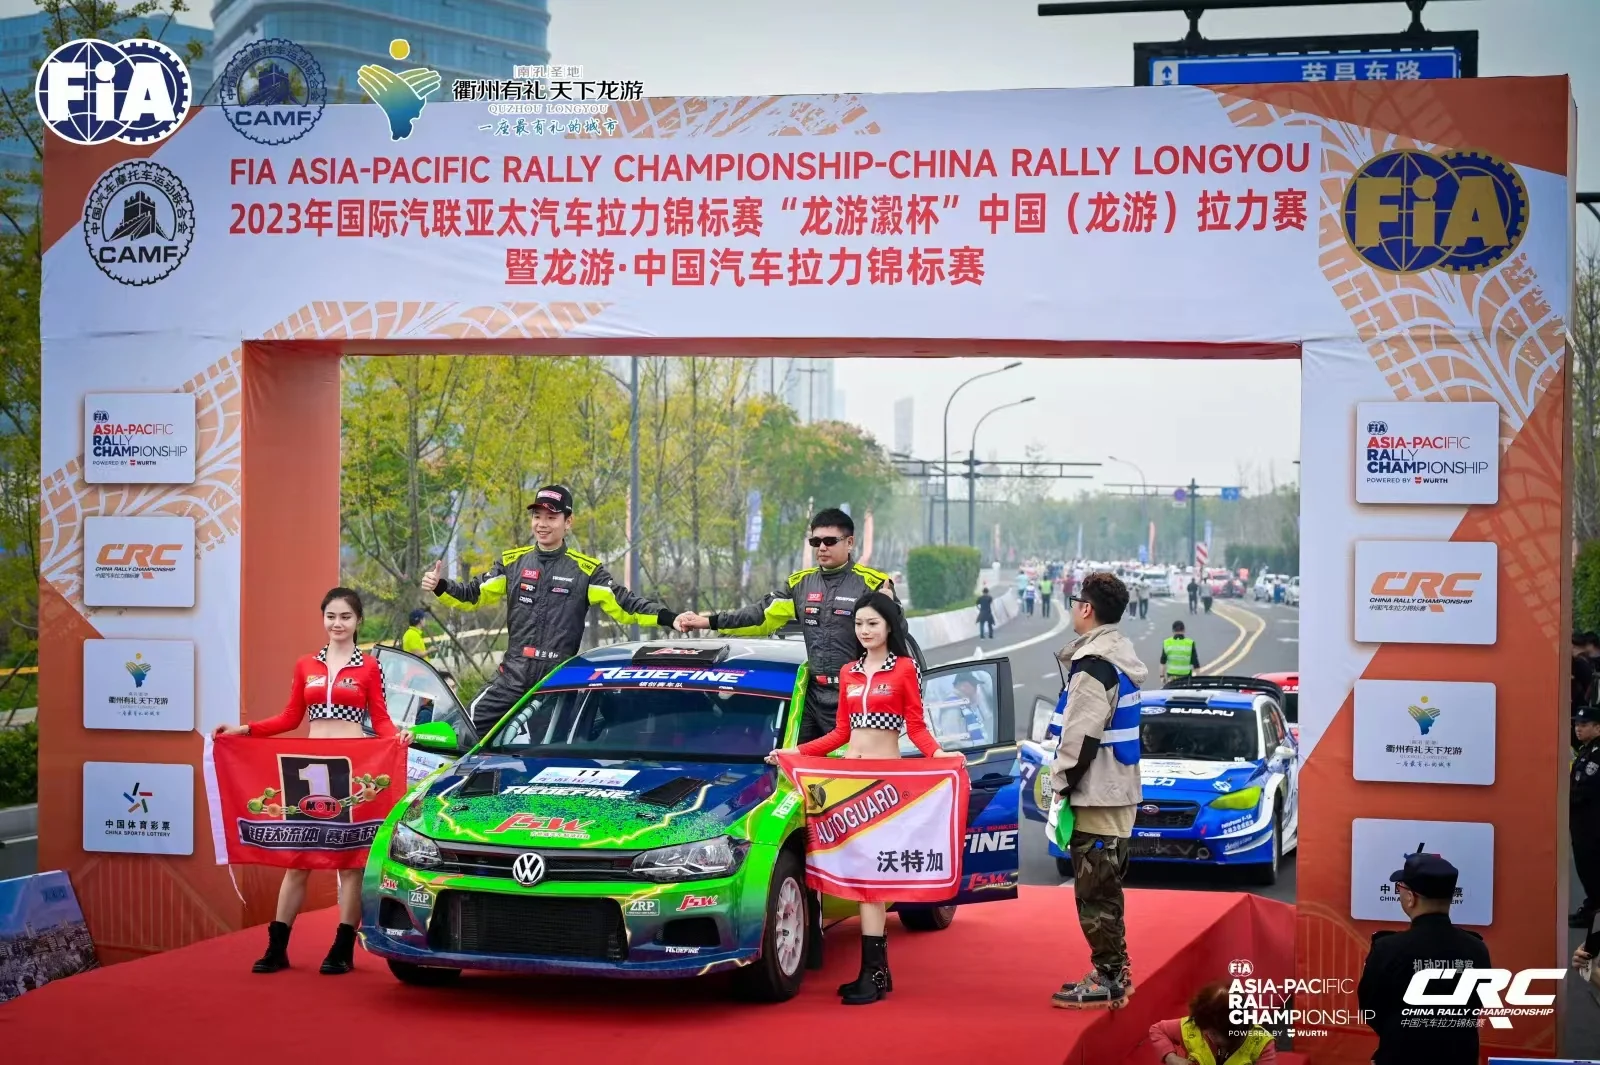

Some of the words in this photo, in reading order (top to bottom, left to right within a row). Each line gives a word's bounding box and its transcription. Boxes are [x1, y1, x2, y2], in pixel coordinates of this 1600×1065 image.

[231, 158, 276, 185] FIA
[289, 155, 489, 185] ASIA-PACIFIC
[503, 155, 601, 183] RALLY
[614, 149, 998, 183] CHAMPIONSHIP-CHINA
[1012, 146, 1120, 177] RALLY
[1134, 143, 1310, 176] LONGYOU
[99, 246, 178, 263] CAMF
[93, 424, 174, 435] ASIA-PACIFIC
[93, 435, 133, 446] RALLY
[1367, 436, 1471, 449] ASIA-PACIFIC
[93, 446, 188, 457] CHAMPIONSHIP
[1367, 449, 1418, 461] RALLY
[1367, 461, 1489, 474] CHAMPIONSHIP
[96, 543, 183, 579] CRC
[1370, 571, 1482, 613] CRC
[587, 667, 746, 684] REDEFINE
[1169, 707, 1235, 717] SUBARU
[1424, 745, 1463, 756] 天下龙游
[299, 763, 331, 796] 1
[577, 769, 600, 777] 11
[815, 782, 900, 844] AUTOGUARD
[105, 819, 171, 831] 中国体育彩票
[876, 849, 943, 873] 沃特加
[410, 891, 430, 904] ZRP
[630, 901, 655, 911] ZRP
